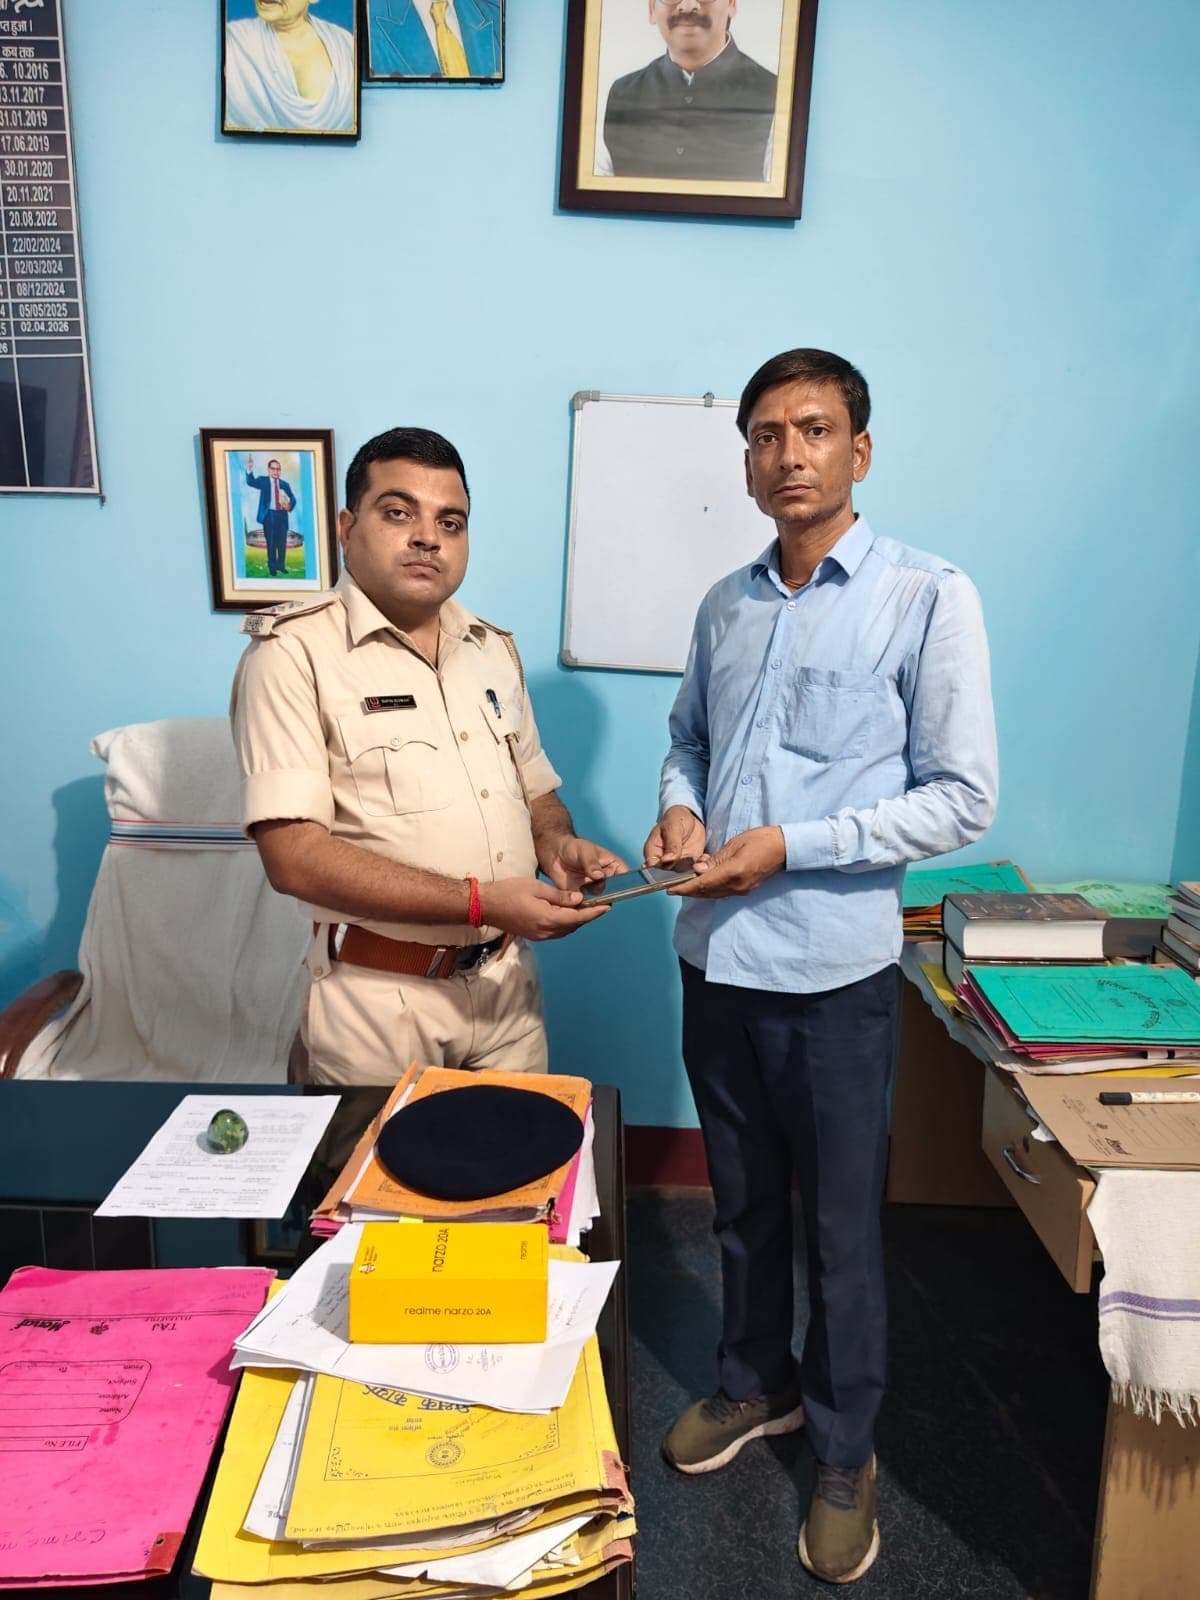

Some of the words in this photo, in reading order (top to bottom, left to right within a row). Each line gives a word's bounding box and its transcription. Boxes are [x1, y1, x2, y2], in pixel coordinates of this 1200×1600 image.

[1, 46, 18, 58] कब
[18, 46, 35, 58] तक
[13, 62, 49, 80] 10.2016
[0, 110, 48, 127] 31.01.2019
[1, 135, 50, 152] 17.06.2019
[4, 160, 53, 177] 30.01.2020
[6, 186, 54, 202] 20.11.2021
[9, 210, 58, 227] 20.08.2022
[12, 237, 61, 253] 22/02/2024
[14, 260, 63, 275] 02/03/2024
[16, 282, 65, 297] 08/12/2024
[19, 303, 68, 318] 05/05/2025
[20, 321, 70, 333] 02.04.2026
[436, 1228, 449, 1243] 20A
[431, 1243, 447, 1273] narzo
[404, 1305, 441, 1316] realme
[444, 1306, 474, 1316] narzo
[475, 1307, 492, 1316] 20A
[151, 1322, 177, 1332] TAJ
[98, 1406, 123, 1415] Name
[43, 1440, 58, 1448] No
[58, 1440, 82, 1448] FILE
